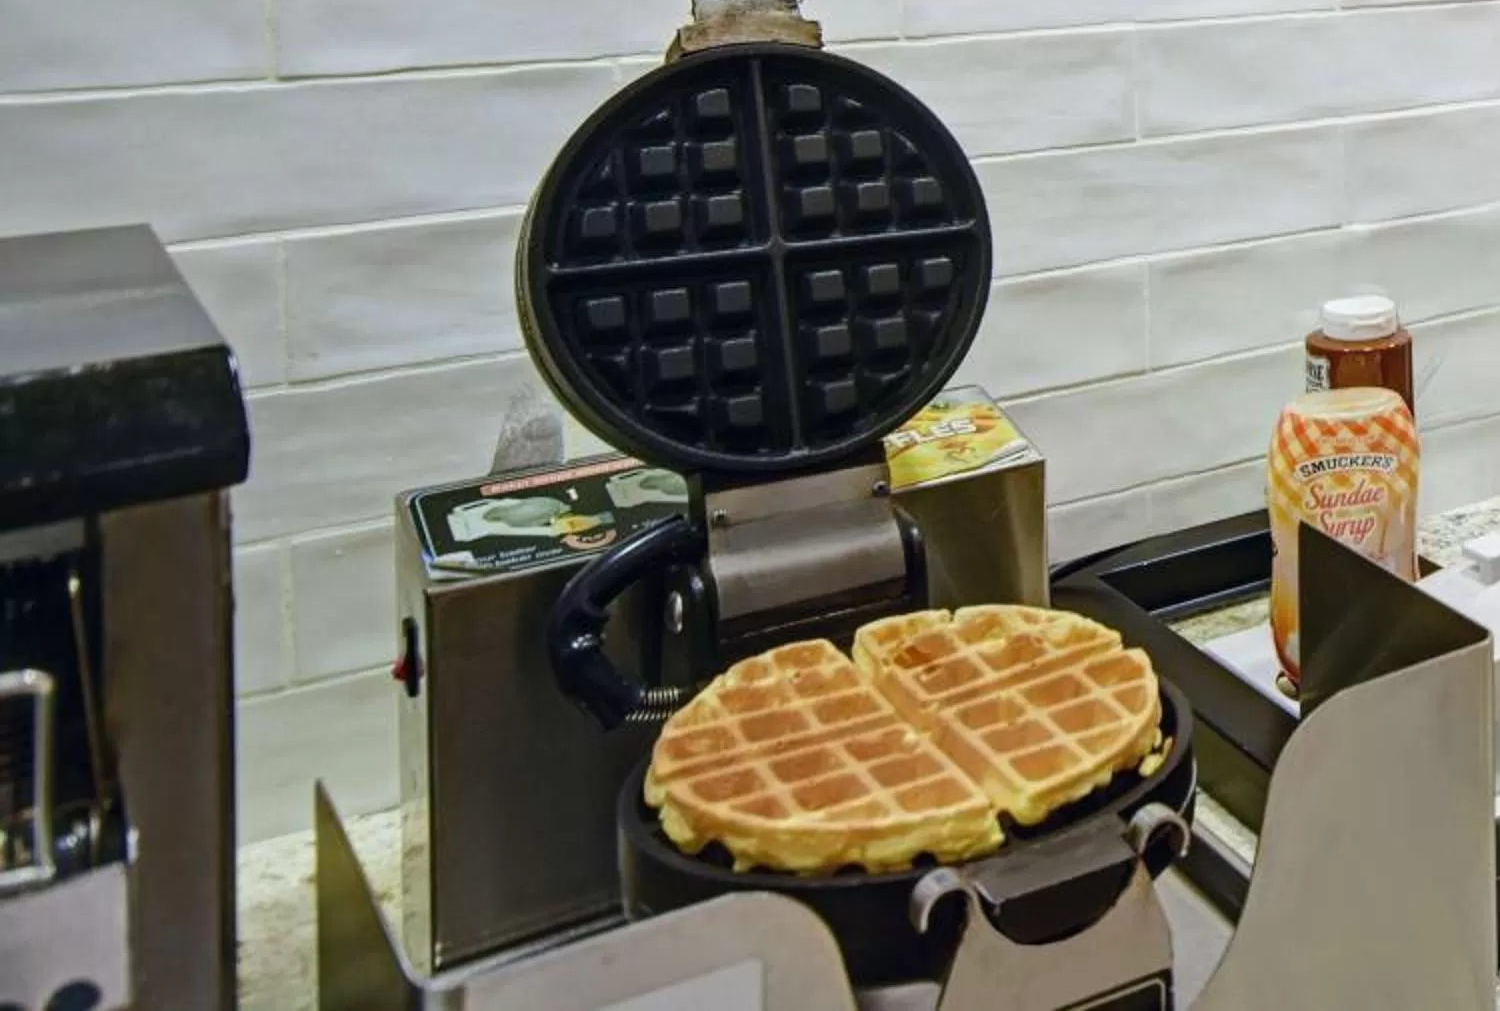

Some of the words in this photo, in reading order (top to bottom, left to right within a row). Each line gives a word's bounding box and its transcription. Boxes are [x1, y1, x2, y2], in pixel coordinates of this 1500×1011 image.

[1299, 455, 1395, 478] SMUCKER'S
[1304, 478, 1386, 510] Sundae
[1320, 510, 1376, 545] Syrup
